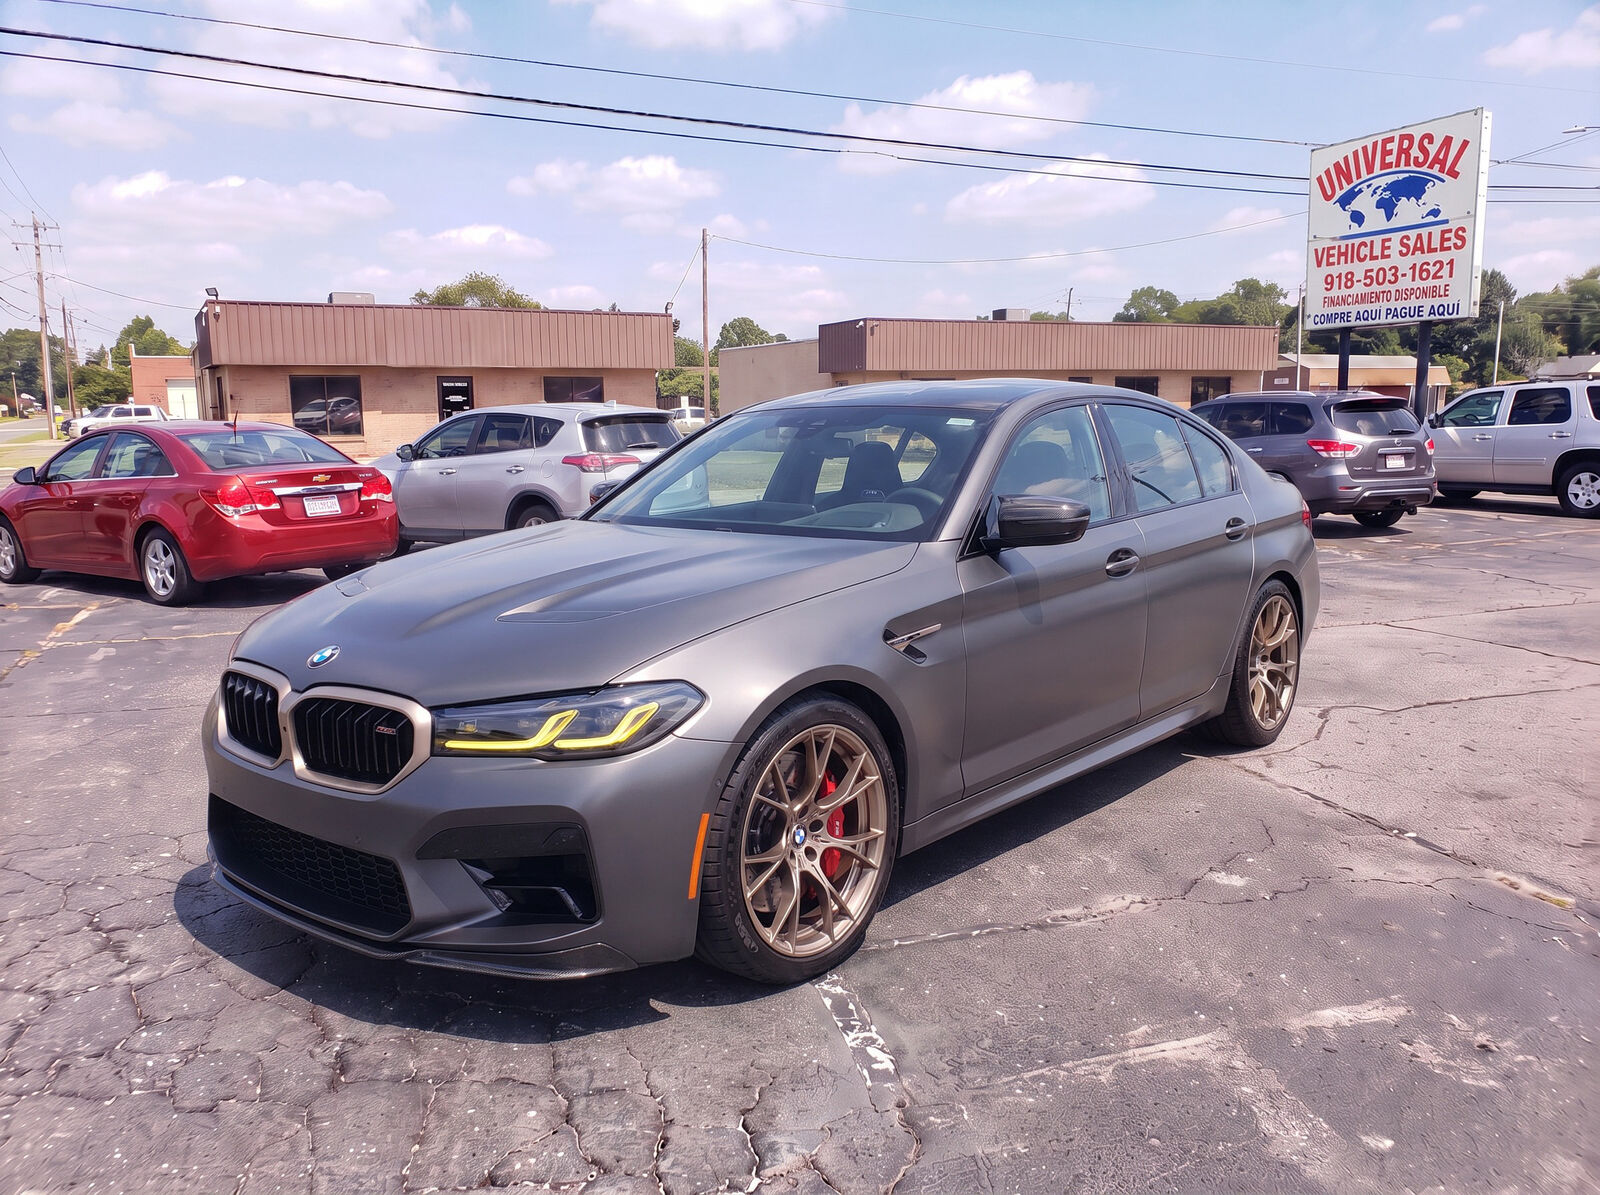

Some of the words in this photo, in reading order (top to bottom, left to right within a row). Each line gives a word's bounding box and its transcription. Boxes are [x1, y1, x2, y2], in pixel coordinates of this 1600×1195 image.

[1316, 132, 1470, 202] UNIVERSAL
[1314, 237, 1392, 268] VEHICLE
[1398, 226, 1467, 257] SALES
[1324, 258, 1455, 292] 918-503-1621
[1313, 311, 1352, 326] COMPRE
[1385, 305, 1424, 320] PAGUE
[1428, 299, 1460, 317] AQUÍ
[1322, 289, 1392, 308] FINANCIAMIENTO
[1394, 284, 1450, 302] DISPONIBLE
